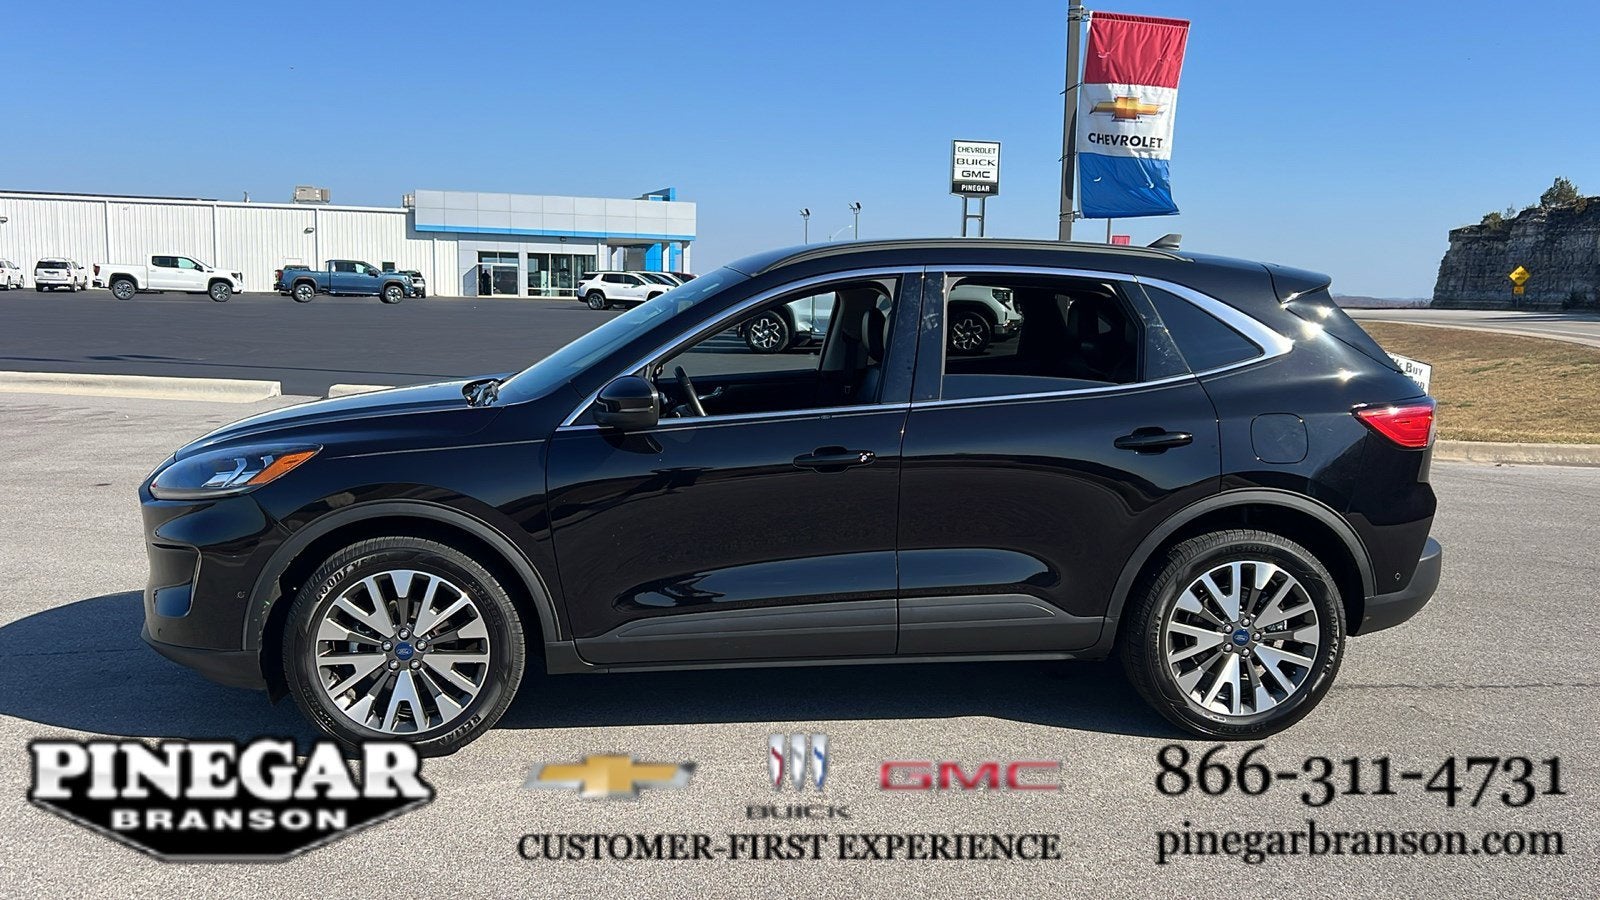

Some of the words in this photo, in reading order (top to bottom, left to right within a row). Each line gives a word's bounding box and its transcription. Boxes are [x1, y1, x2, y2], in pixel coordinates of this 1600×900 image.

[1087, 132, 1163, 149] CHEVROLET
[957, 146, 997, 155] CHEVROLET
[956, 158, 996, 167] BUICK
[961, 170, 991, 179] GMC
[961, 184, 990, 192] PINEGAR
